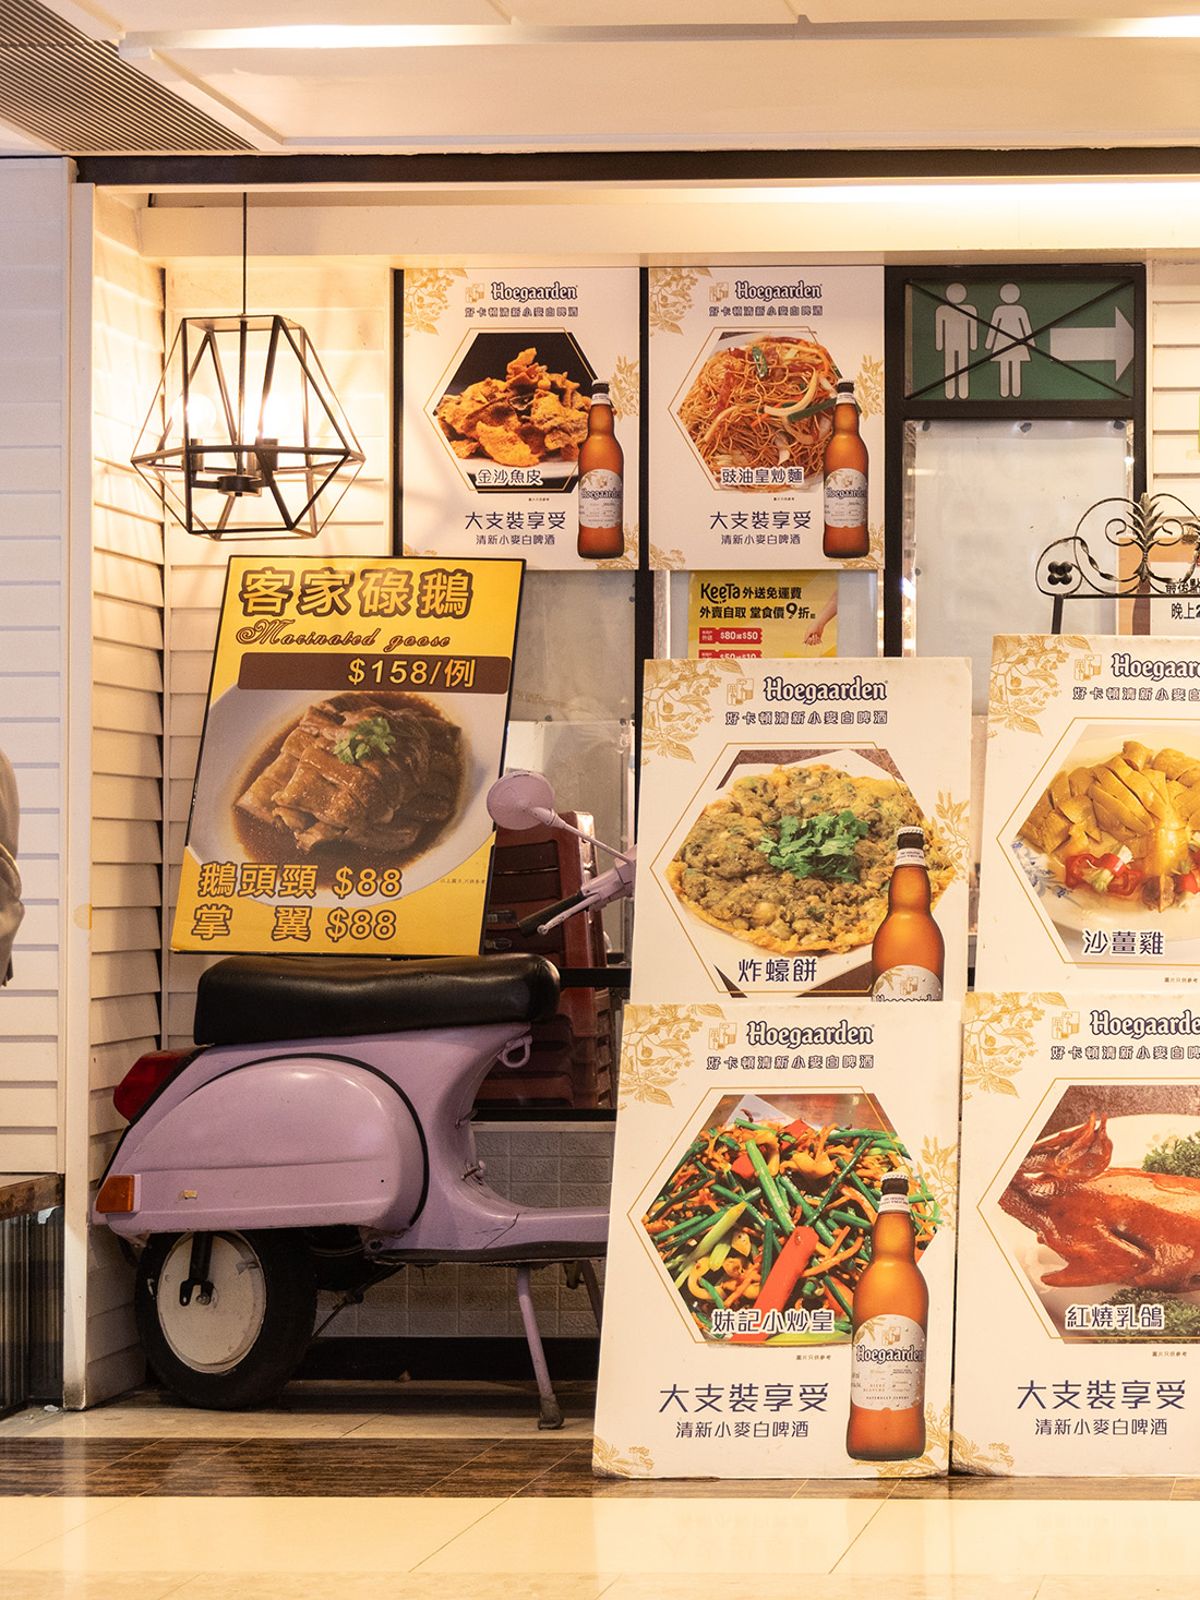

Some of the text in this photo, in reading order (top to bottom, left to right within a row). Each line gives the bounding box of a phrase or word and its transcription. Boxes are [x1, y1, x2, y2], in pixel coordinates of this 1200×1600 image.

[491, 281, 578, 303] Hoegaarden
[735, 280, 822, 302] Hoegaarden
[476, 468, 543, 486] 金沙魚皮
[464, 511, 567, 530] 大支裝享受
[709, 510, 812, 530] 大支裝享受
[475, 534, 556, 546] 清新小麥白啤酒
[720, 533, 801, 545] 清新小麥白啤酒
[239, 567, 475, 620] 客家碌鵝
[701, 583, 802, 603] KeeTa 外送免運費
[700, 606, 746, 619] 外賣自取
[236, 619, 451, 653] Marinated goose
[348, 657, 476, 689] $158/例
[763, 675, 887, 705] Hoegaarden
[198, 862, 403, 899] 鵝頭頸 $88
[192, 904, 397, 942] 掌 翼 $88
[1082, 929, 1165, 956] 沙薑雞
[738, 958, 818, 983] 炸蠔餅
[746, 1019, 873, 1050] Hoegaarden
[706, 1055, 874, 1070] 好卡頓清新小麥白啤酒
[711, 1309, 835, 1334] 妹記小炒皇
[1066, 1305, 1164, 1330] 紅燒乳鴿
[659, 1382, 830, 1414] 大支裝享受
[1017, 1379, 1186, 1411] 大支裝享受
[675, 1421, 809, 1439] 清新小麥白啤酒
[1035, 1418, 1168, 1437] 清新小麥白啤酒
